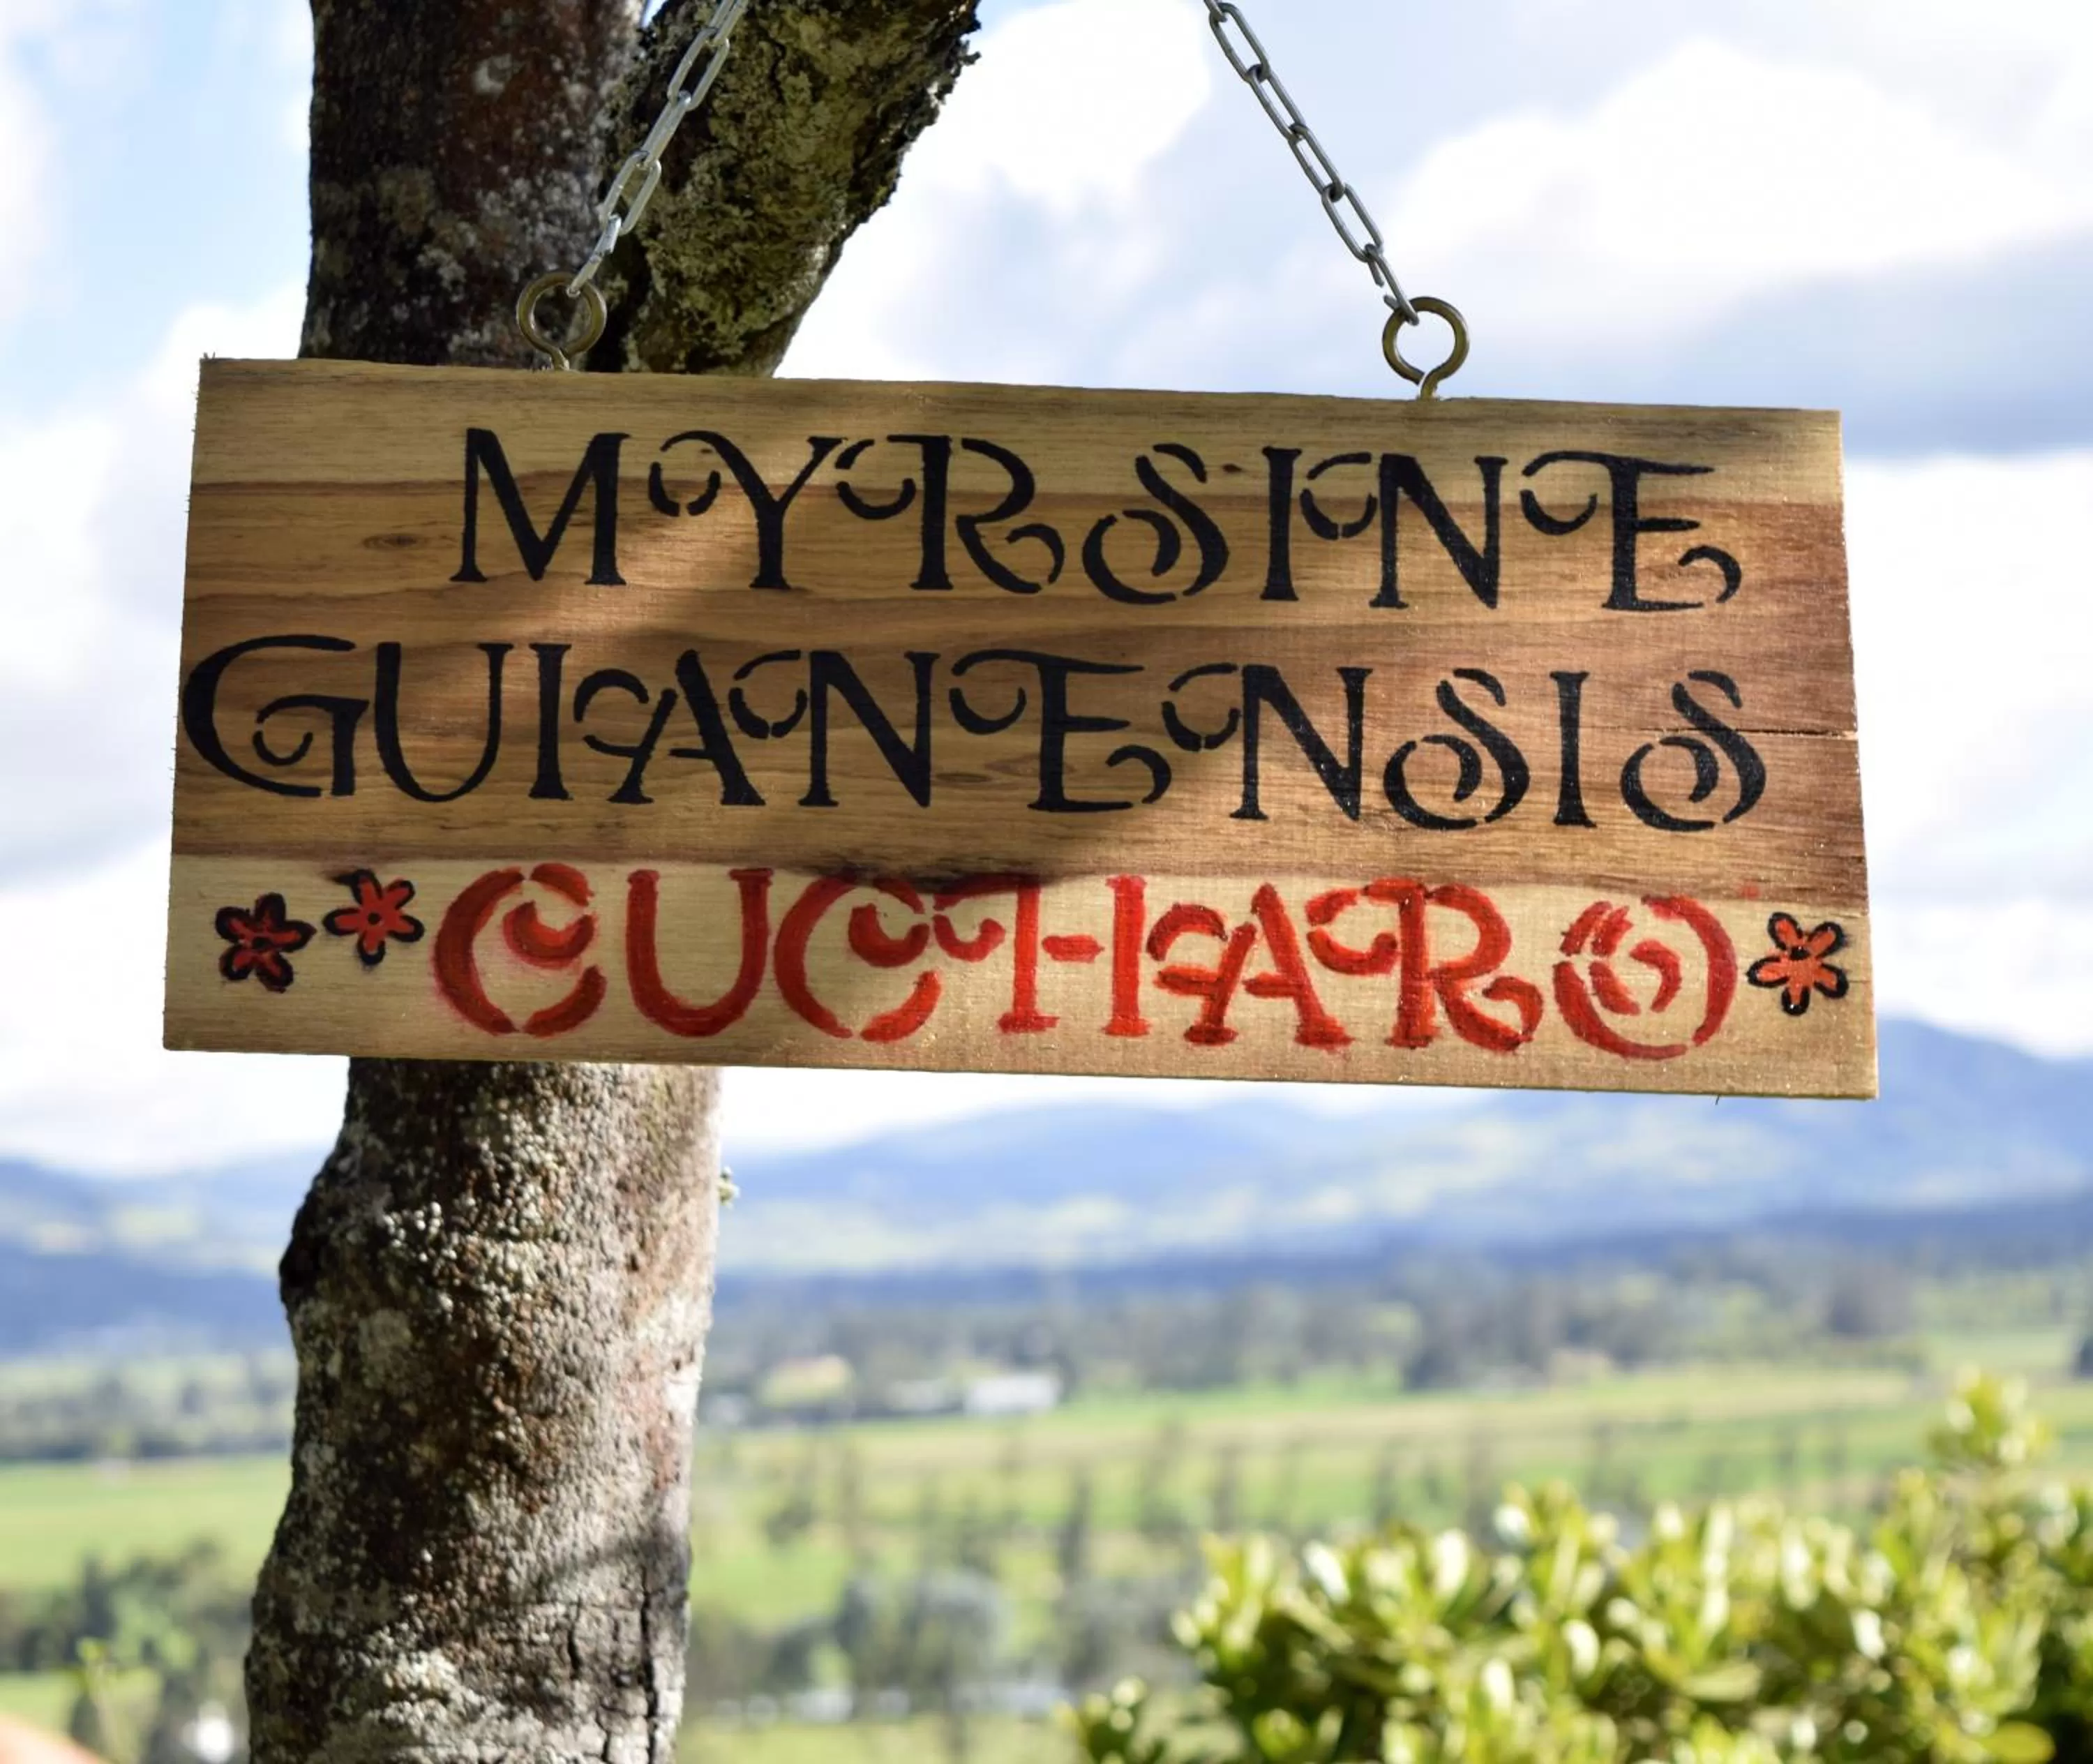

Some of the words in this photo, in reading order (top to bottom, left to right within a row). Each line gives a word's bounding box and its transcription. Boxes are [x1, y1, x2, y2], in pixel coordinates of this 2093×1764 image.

[449, 426, 1742, 611] MYRSINE
[181, 634, 1767, 832] GUIANENSIS
[430, 862, 1738, 1060] CUCHARO
